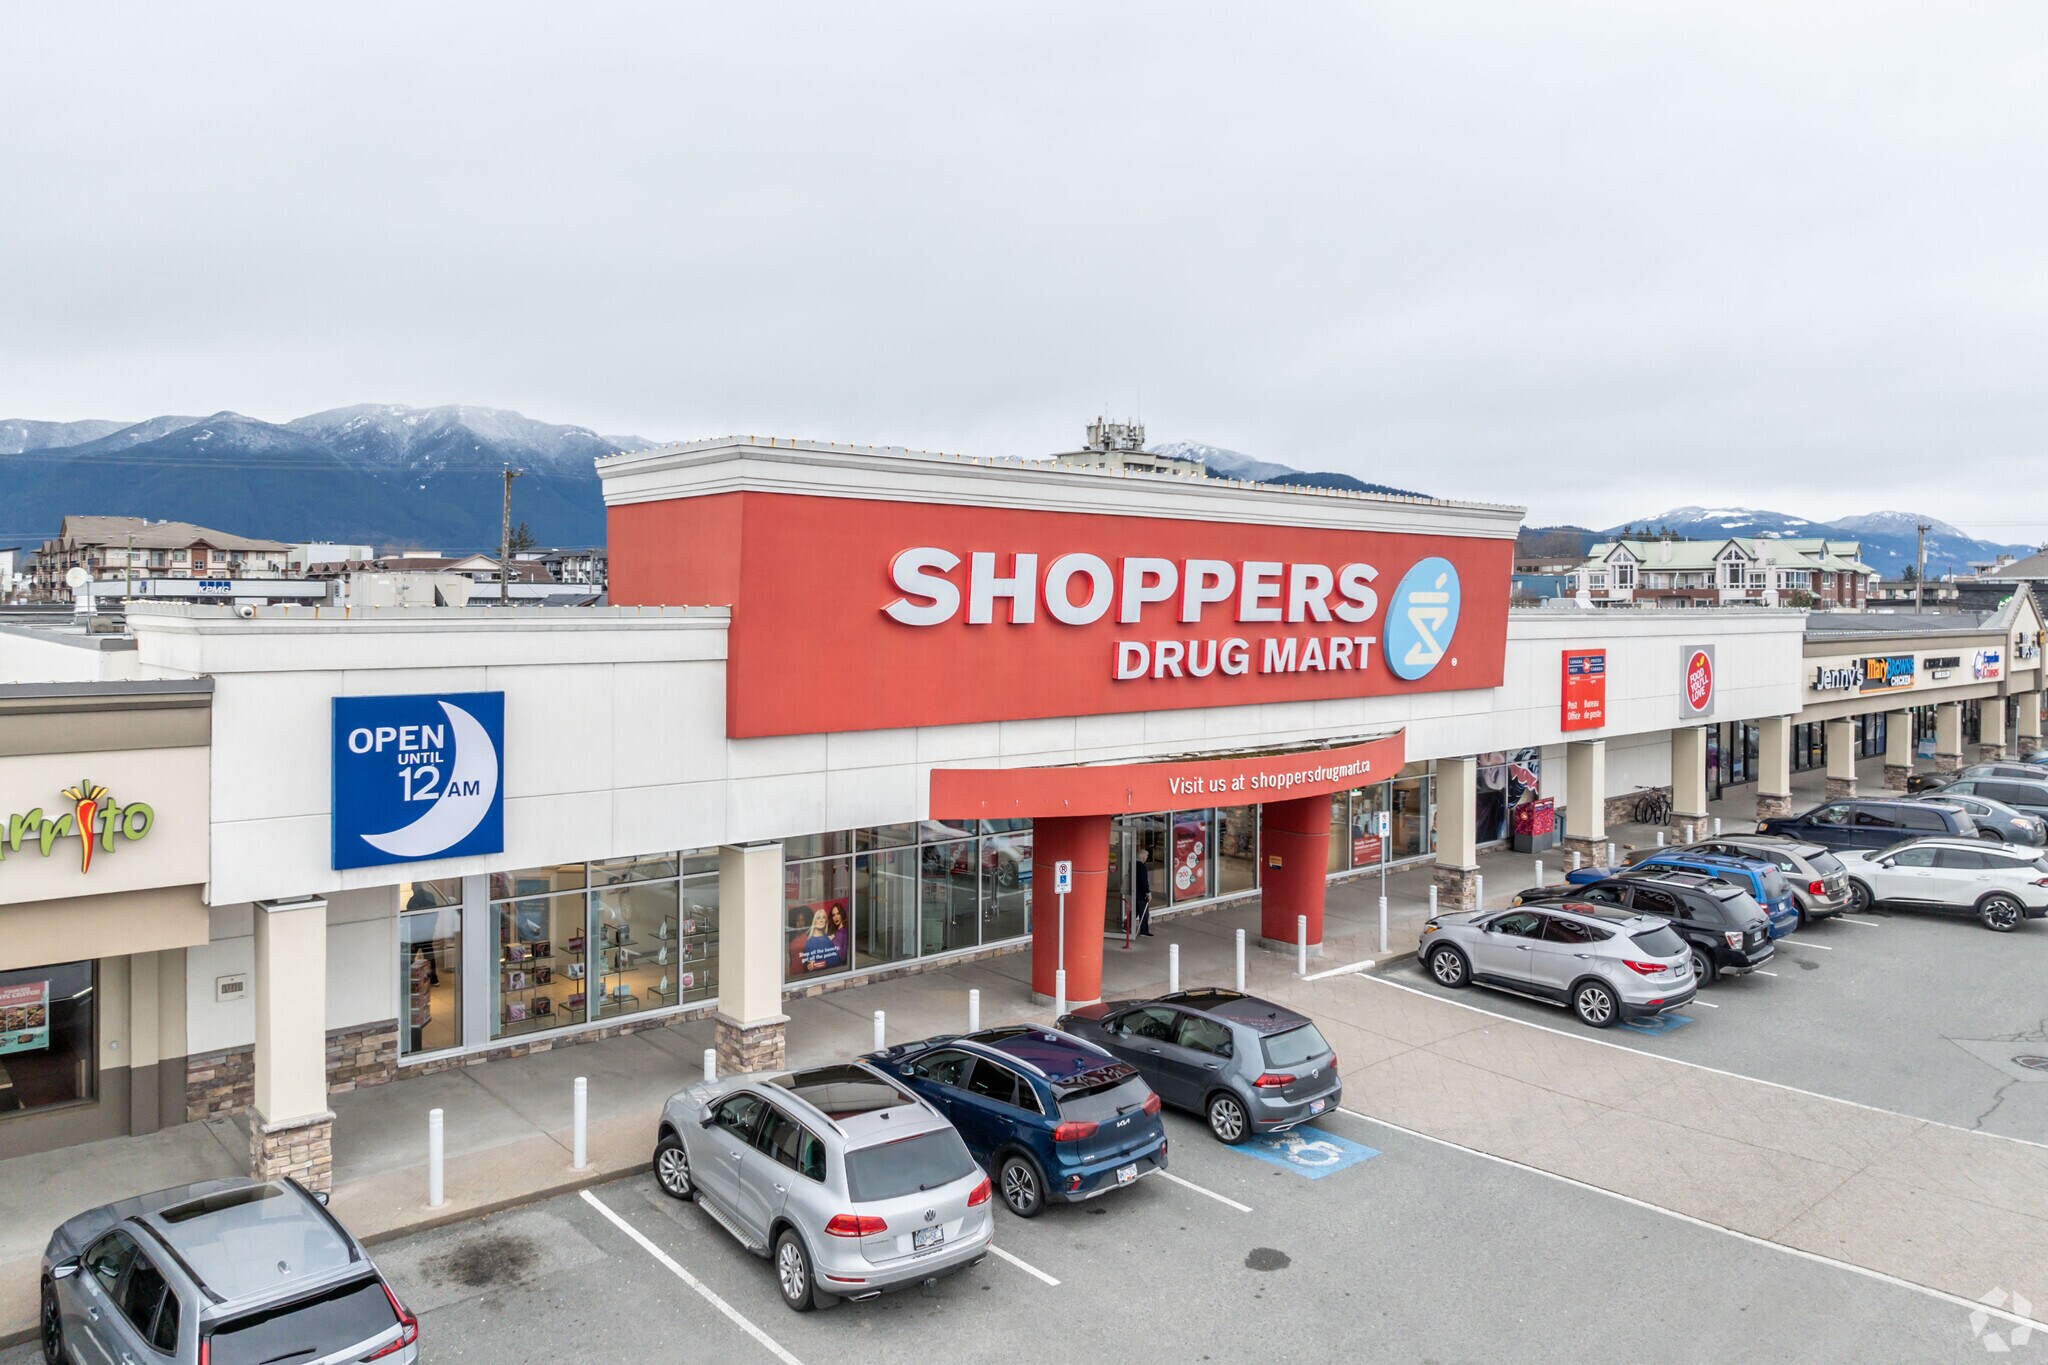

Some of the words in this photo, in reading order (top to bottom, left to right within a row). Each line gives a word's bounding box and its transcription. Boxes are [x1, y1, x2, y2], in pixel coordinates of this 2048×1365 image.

[880, 546, 1380, 627] SHOPPERS
[1112, 638, 1250, 681] DRUG
[1259, 636, 1377, 675] MART
[1690, 667, 1705, 684] FOOD
[1817, 664, 1864, 691] Jenny's
[1891, 675, 1911, 686] CHICKEN
[1692, 686, 1706, 702] LOVE
[1567, 701, 1578, 710] Post
[1583, 699, 1600, 708] Bureau
[1567, 711, 1581, 720] Office
[1583, 710, 1590, 719] de
[1589, 710, 1602, 720] poste
[348, 724, 445, 754] OPEN
[398, 752, 444, 765] UNTIL
[398, 765, 440, 802] 12
[448, 780, 480, 797] AM
[1169, 777, 1204, 795] Visit
[1209, 778, 1227, 792] us
[1231, 774, 1245, 791] at
[1250, 760, 1371, 790] shoppersdrugmart.ca
[0, 779, 154, 875] rrito
